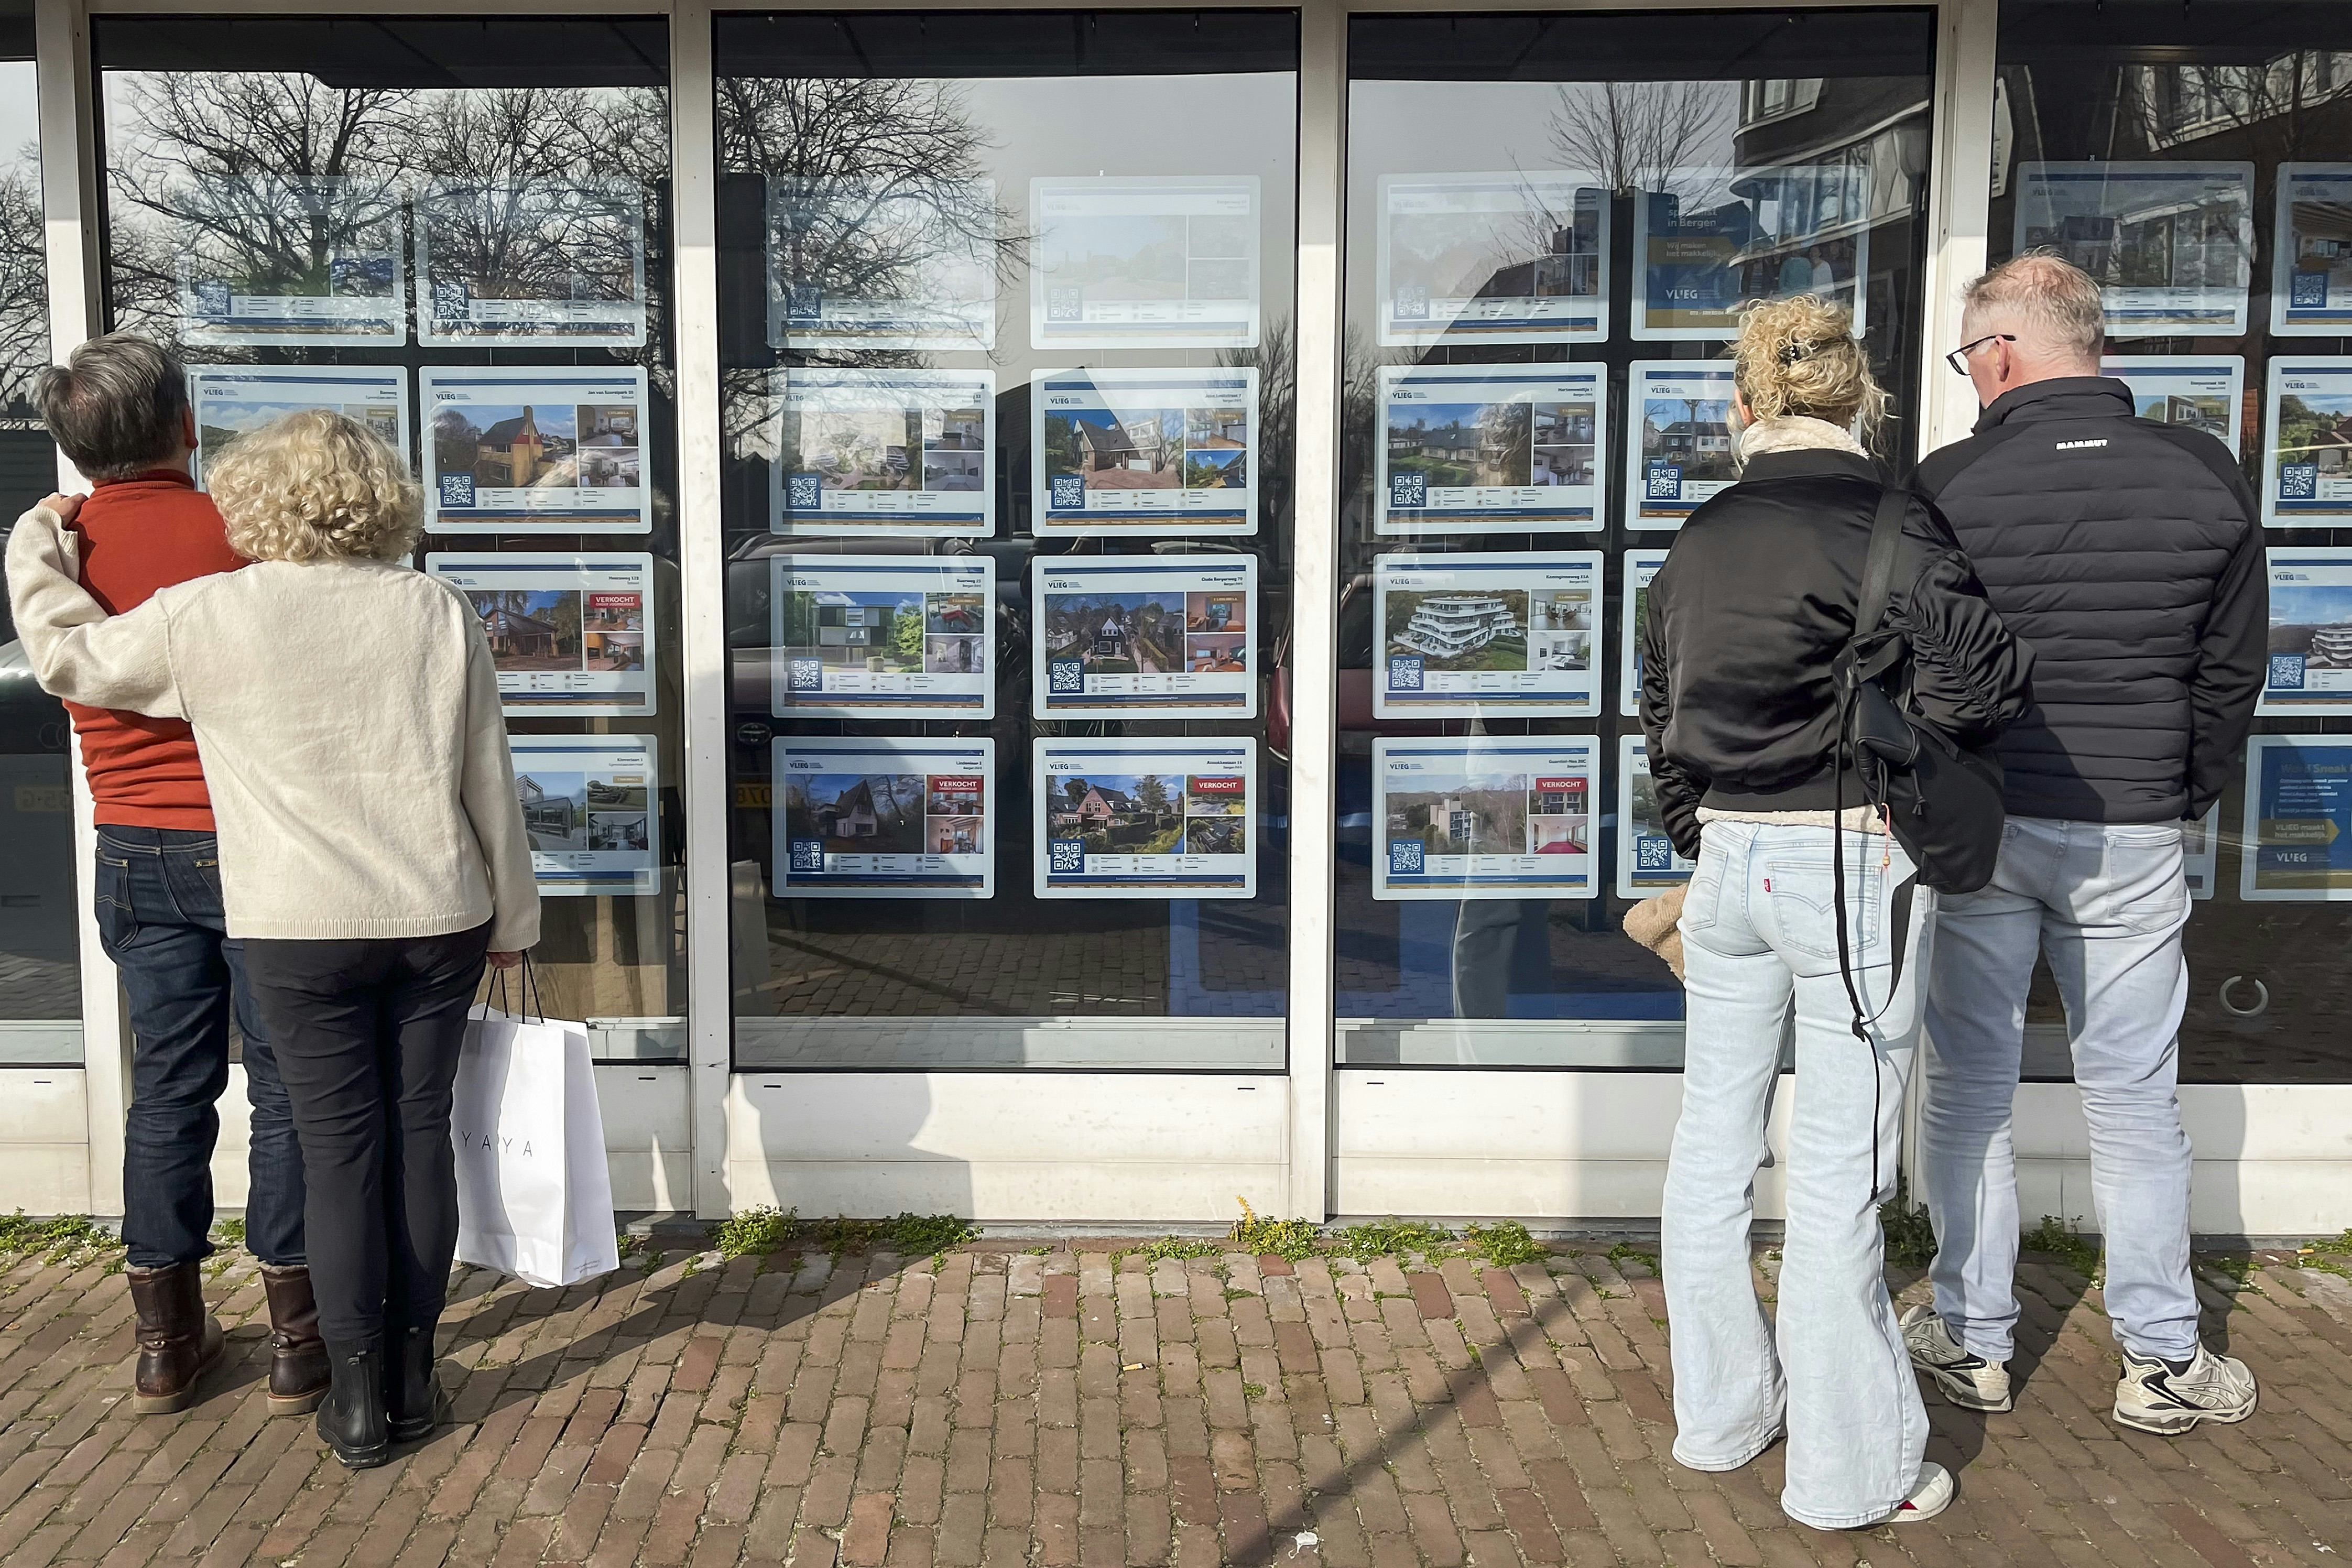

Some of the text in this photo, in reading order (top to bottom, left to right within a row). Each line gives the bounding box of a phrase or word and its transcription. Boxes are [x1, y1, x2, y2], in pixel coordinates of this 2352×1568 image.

[1668, 218, 1716, 229] in Bergen
[1666, 289, 1697, 299] VLIEG
[2056, 439, 2108, 450] MAMMUT
[2313, 764, 2348, 773] Sneak
[2277, 853, 2307, 862] VLIEG
[462, 1131, 532, 1157] YAYA
